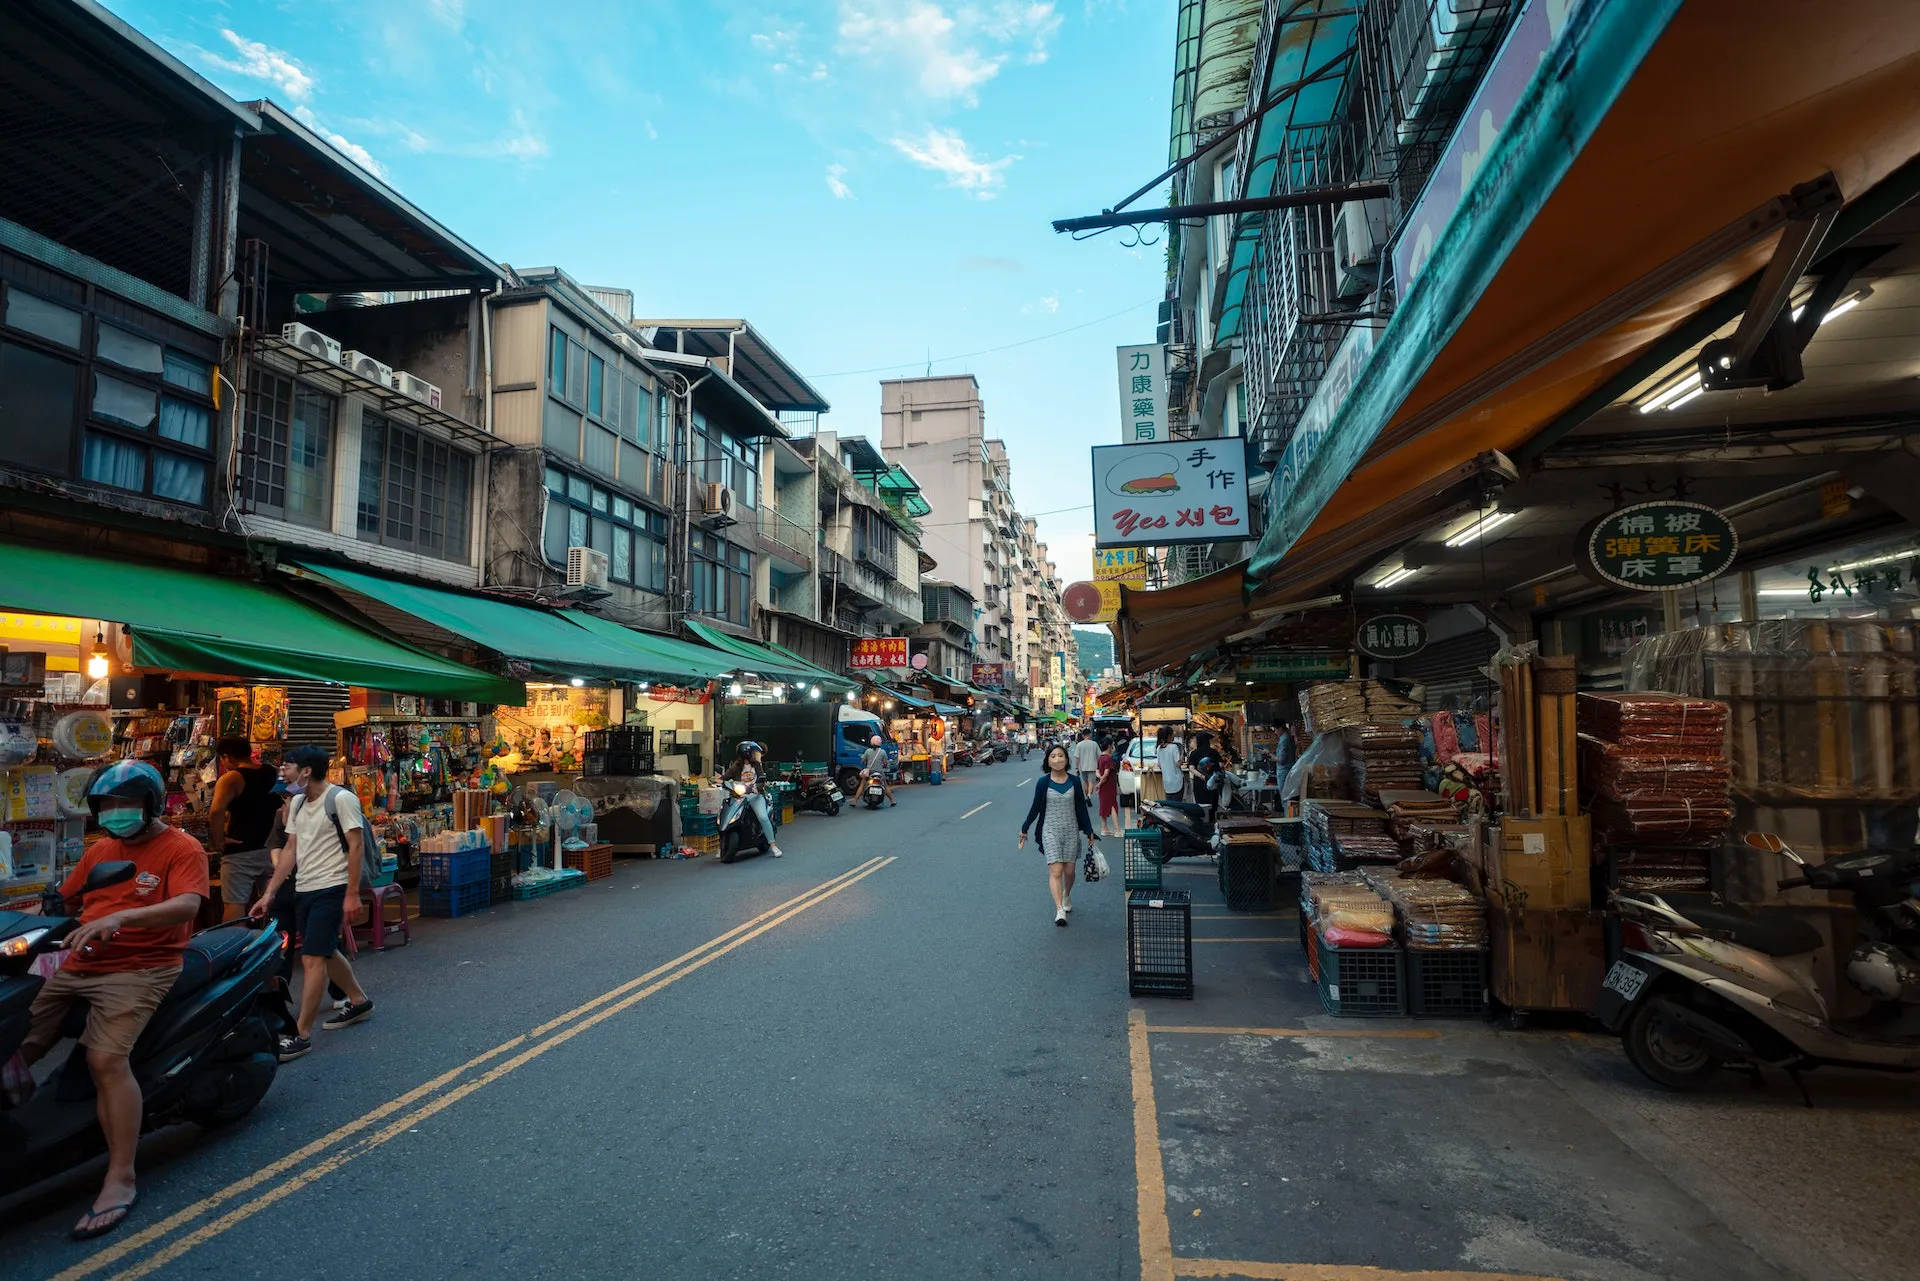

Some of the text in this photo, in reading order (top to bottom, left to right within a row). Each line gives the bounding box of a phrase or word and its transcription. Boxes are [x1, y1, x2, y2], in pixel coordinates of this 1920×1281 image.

[1130, 352, 1155, 441] 力康藥局
[1187, 448, 1235, 490] 手作
[1112, 504, 1240, 537] Yes 刈包
[1618, 512, 1702, 535] 棉被
[1605, 534, 1721, 558] 彈簧床
[1620, 556, 1703, 579] 床罩
